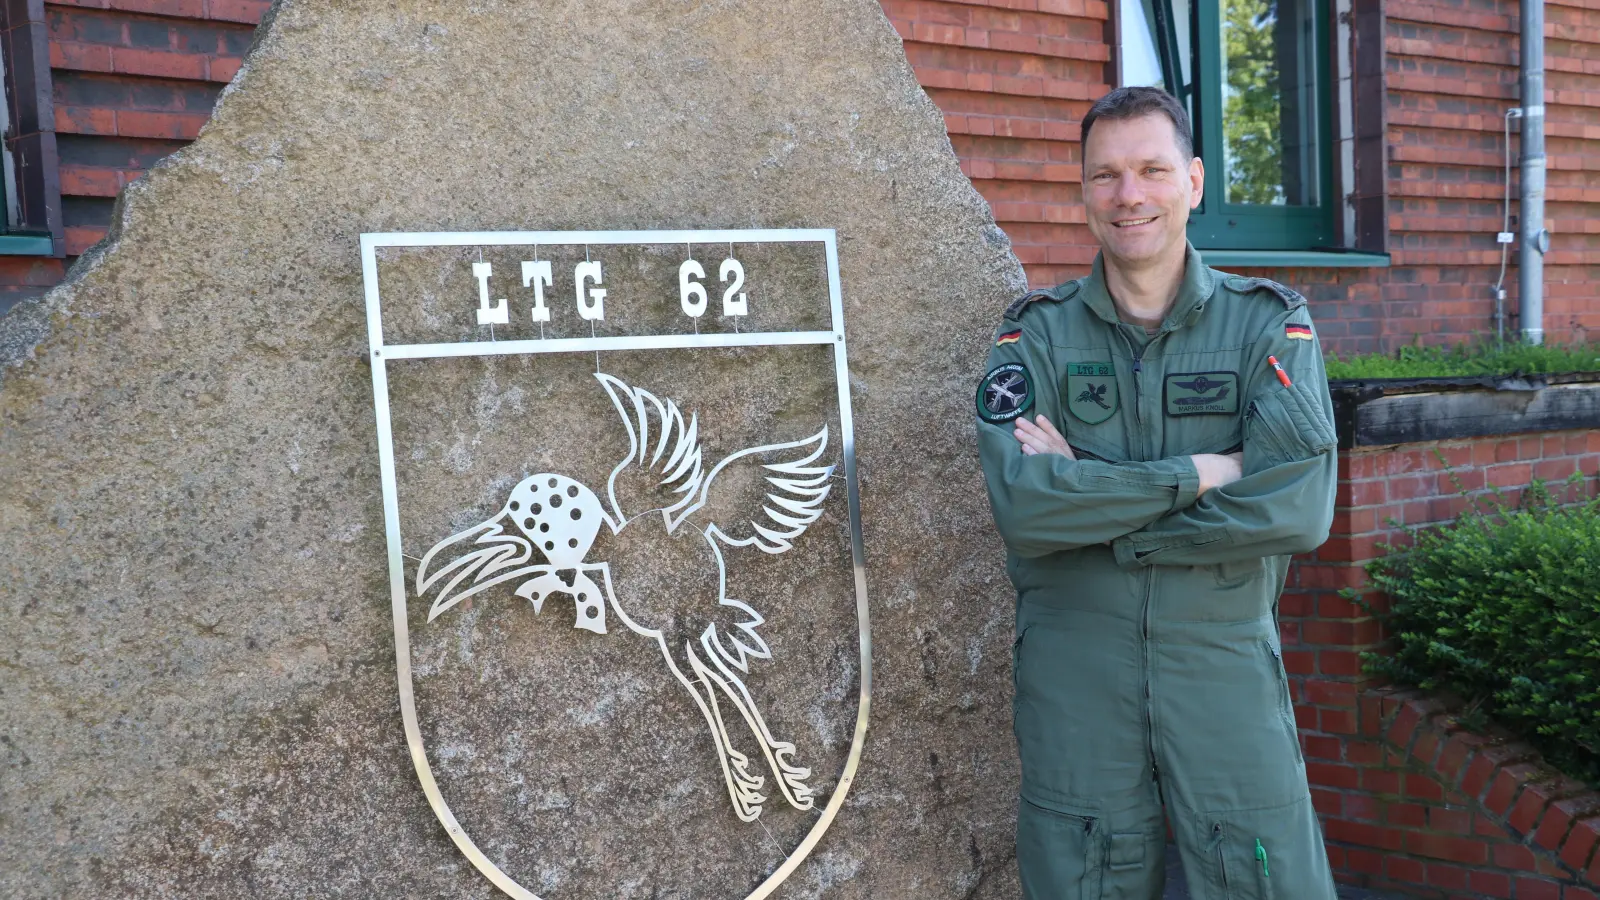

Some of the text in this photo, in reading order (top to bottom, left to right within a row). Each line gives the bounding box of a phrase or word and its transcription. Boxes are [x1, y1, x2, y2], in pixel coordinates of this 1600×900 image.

[472, 258, 748, 325] LTG 62
[1077, 366, 1109, 375] LTG 62
[991, 407, 1023, 420] LUFTWAFFE
